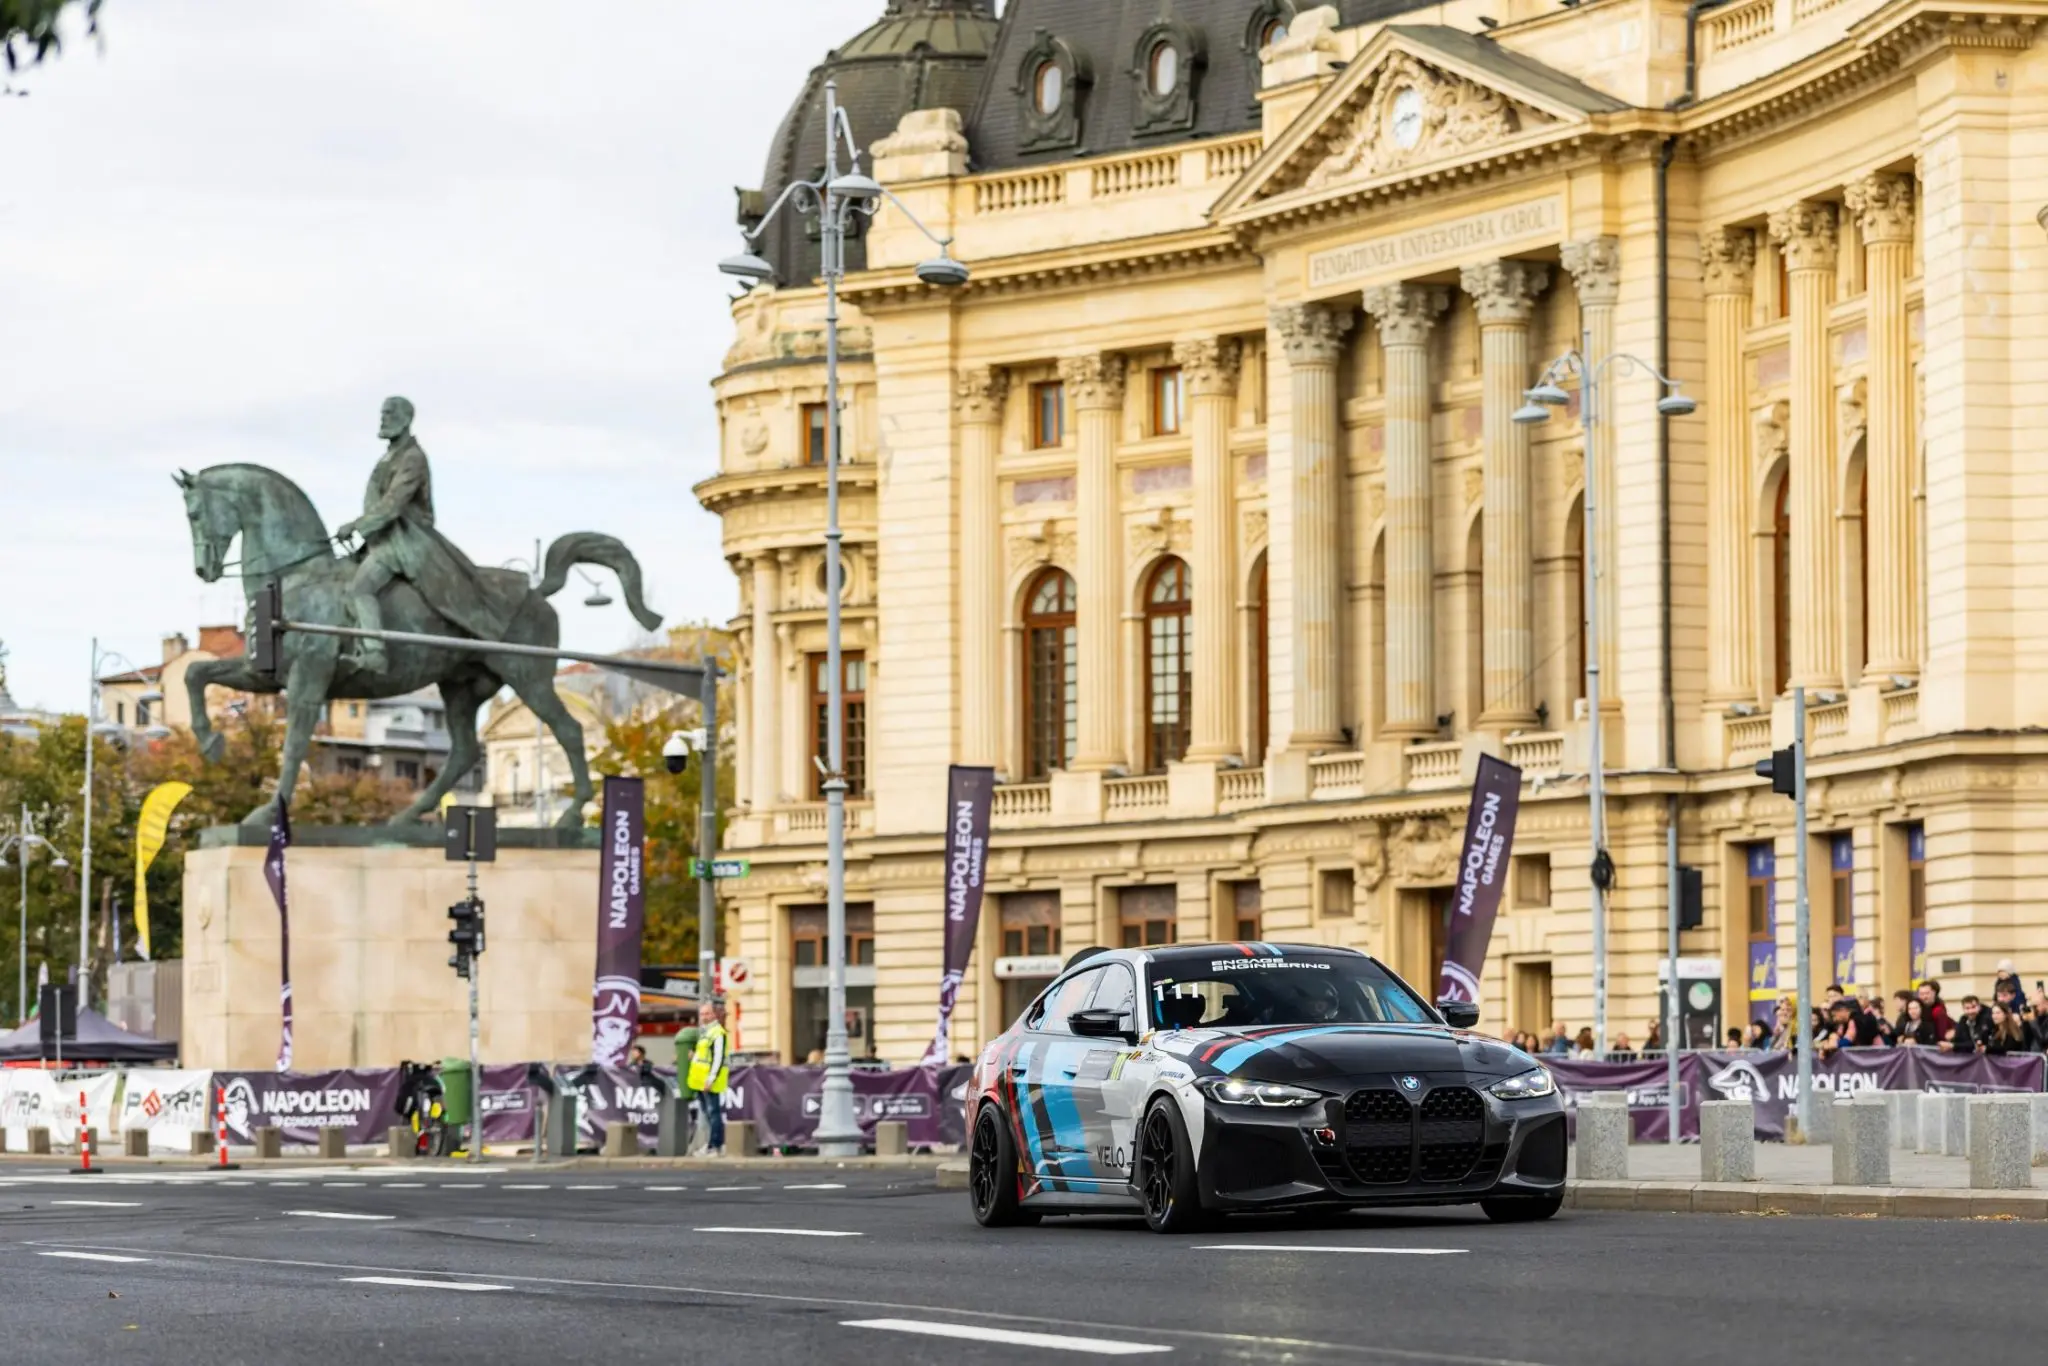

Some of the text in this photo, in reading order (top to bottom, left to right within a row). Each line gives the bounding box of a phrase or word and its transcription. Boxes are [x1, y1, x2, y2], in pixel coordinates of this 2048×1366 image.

[1500, 205, 1546, 235] CAROL
[1549, 202, 1557, 223] I
[609, 810, 631, 929] NAPOLEON
[629, 846, 641, 895] GAMES
[950, 800, 973, 921] NAPOLEON
[969, 837, 983, 887] GAMES
[1459, 792, 1502, 916] NAPOLEON
[1481, 834, 1505, 885] GAMES
[1211, 957, 1284, 967] ENGAGE
[1212, 963, 1331, 972] ENGINEERING
[1153, 982, 1199, 1001] 111
[263, 1088, 370, 1113] NAPOLEON
[1096, 1144, 1125, 1168] VELO
